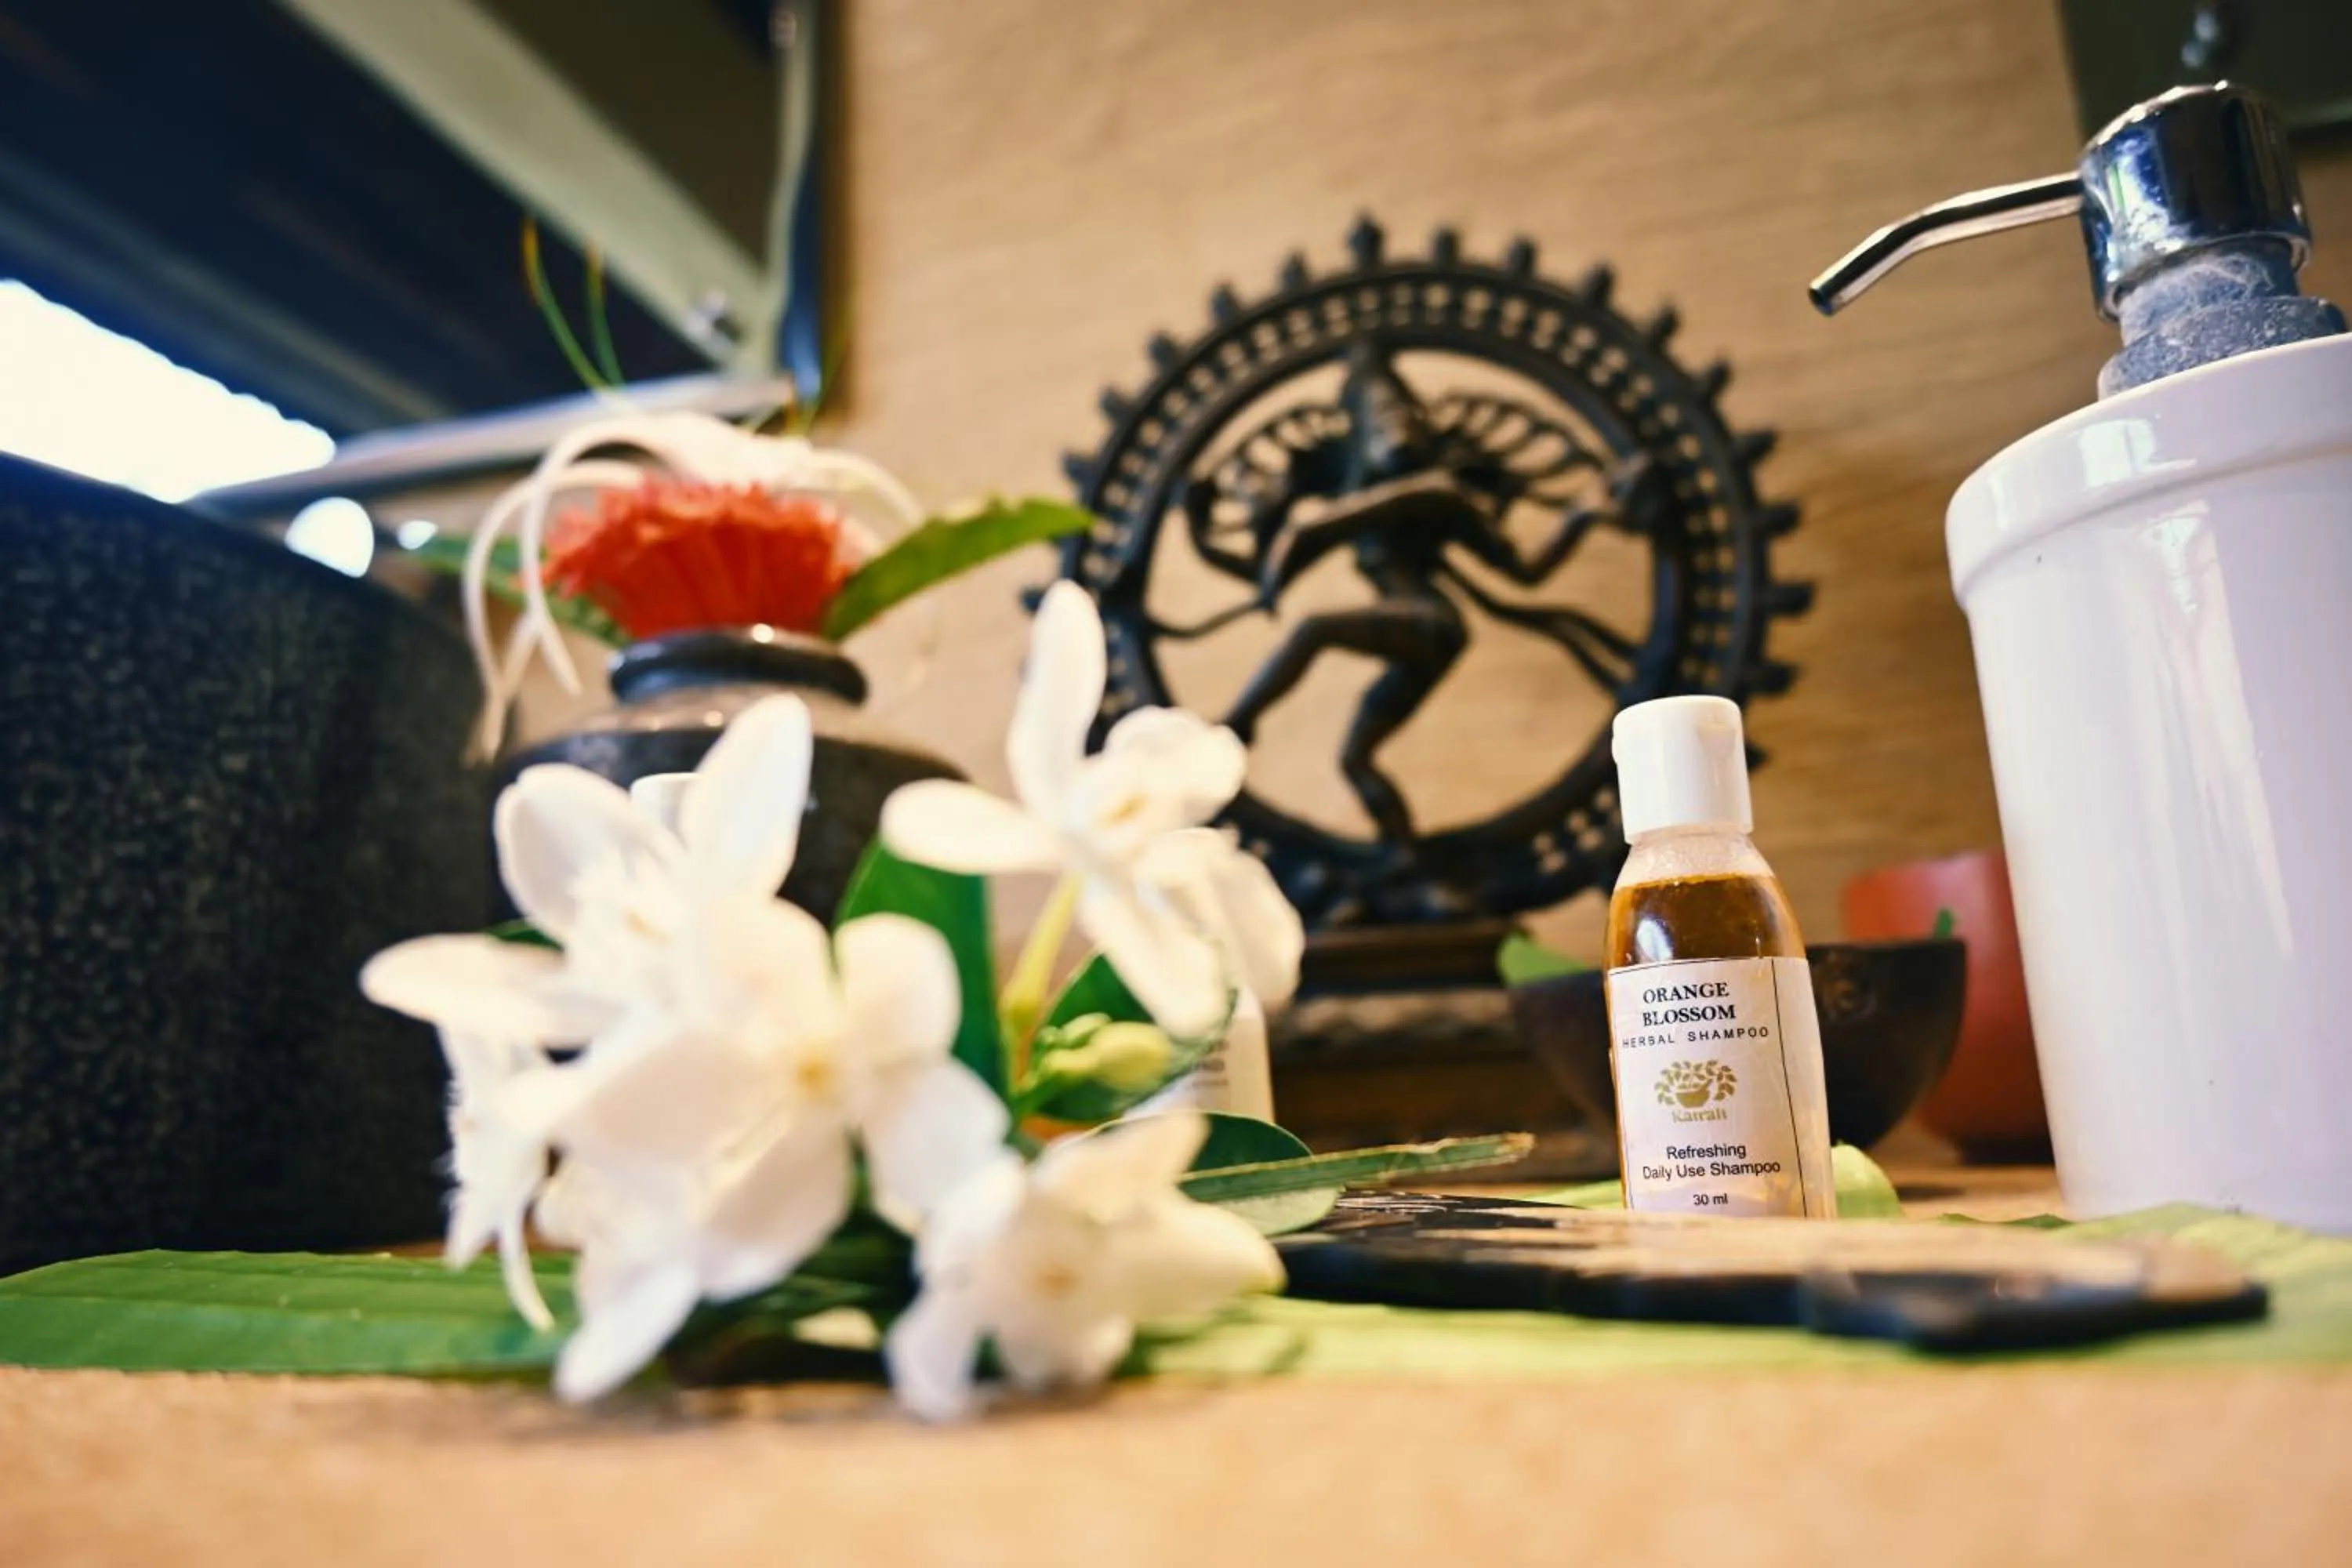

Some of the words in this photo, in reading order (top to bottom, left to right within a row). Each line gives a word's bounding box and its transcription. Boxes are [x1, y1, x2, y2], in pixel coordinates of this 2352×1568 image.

[1643, 982, 1730, 1004] ORANGE
[1643, 1004, 1737, 1027] BLOSSOM
[1623, 1034, 1675, 1048] HERBAL
[1688, 1026, 1769, 1042] SHAMPOO
[1666, 1145, 1747, 1160] Refreshing
[1643, 1164, 1672, 1181] Daily
[1676, 1163, 1705, 1178] Use
[1711, 1161, 1780, 1178] Shampoo
[1693, 1194, 1709, 1206] 30
[1713, 1193, 1728, 1205] ml
